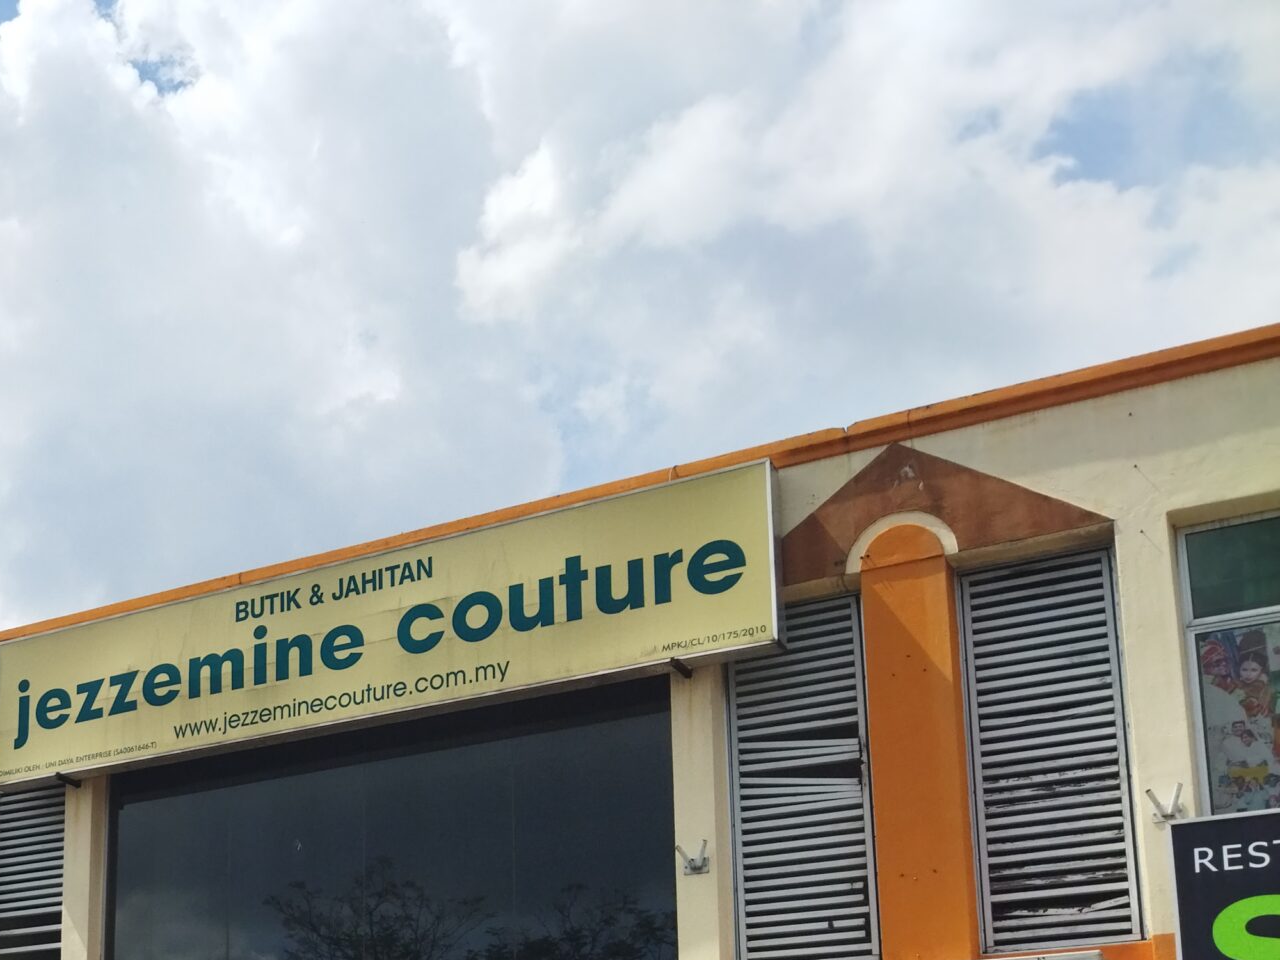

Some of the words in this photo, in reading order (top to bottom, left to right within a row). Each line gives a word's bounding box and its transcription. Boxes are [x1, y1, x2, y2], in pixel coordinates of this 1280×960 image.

[235, 588, 301, 622] BUTIK
[309, 584, 324, 606] &
[332, 556, 433, 600] JAHITAN
[14, 624, 365, 750] jezzemine
[397, 539, 746, 654] couture
[661, 625, 767, 652] MPKJ/CL/10/175/2010
[173, 660, 510, 739] www.jezzeminecouture.com.my
